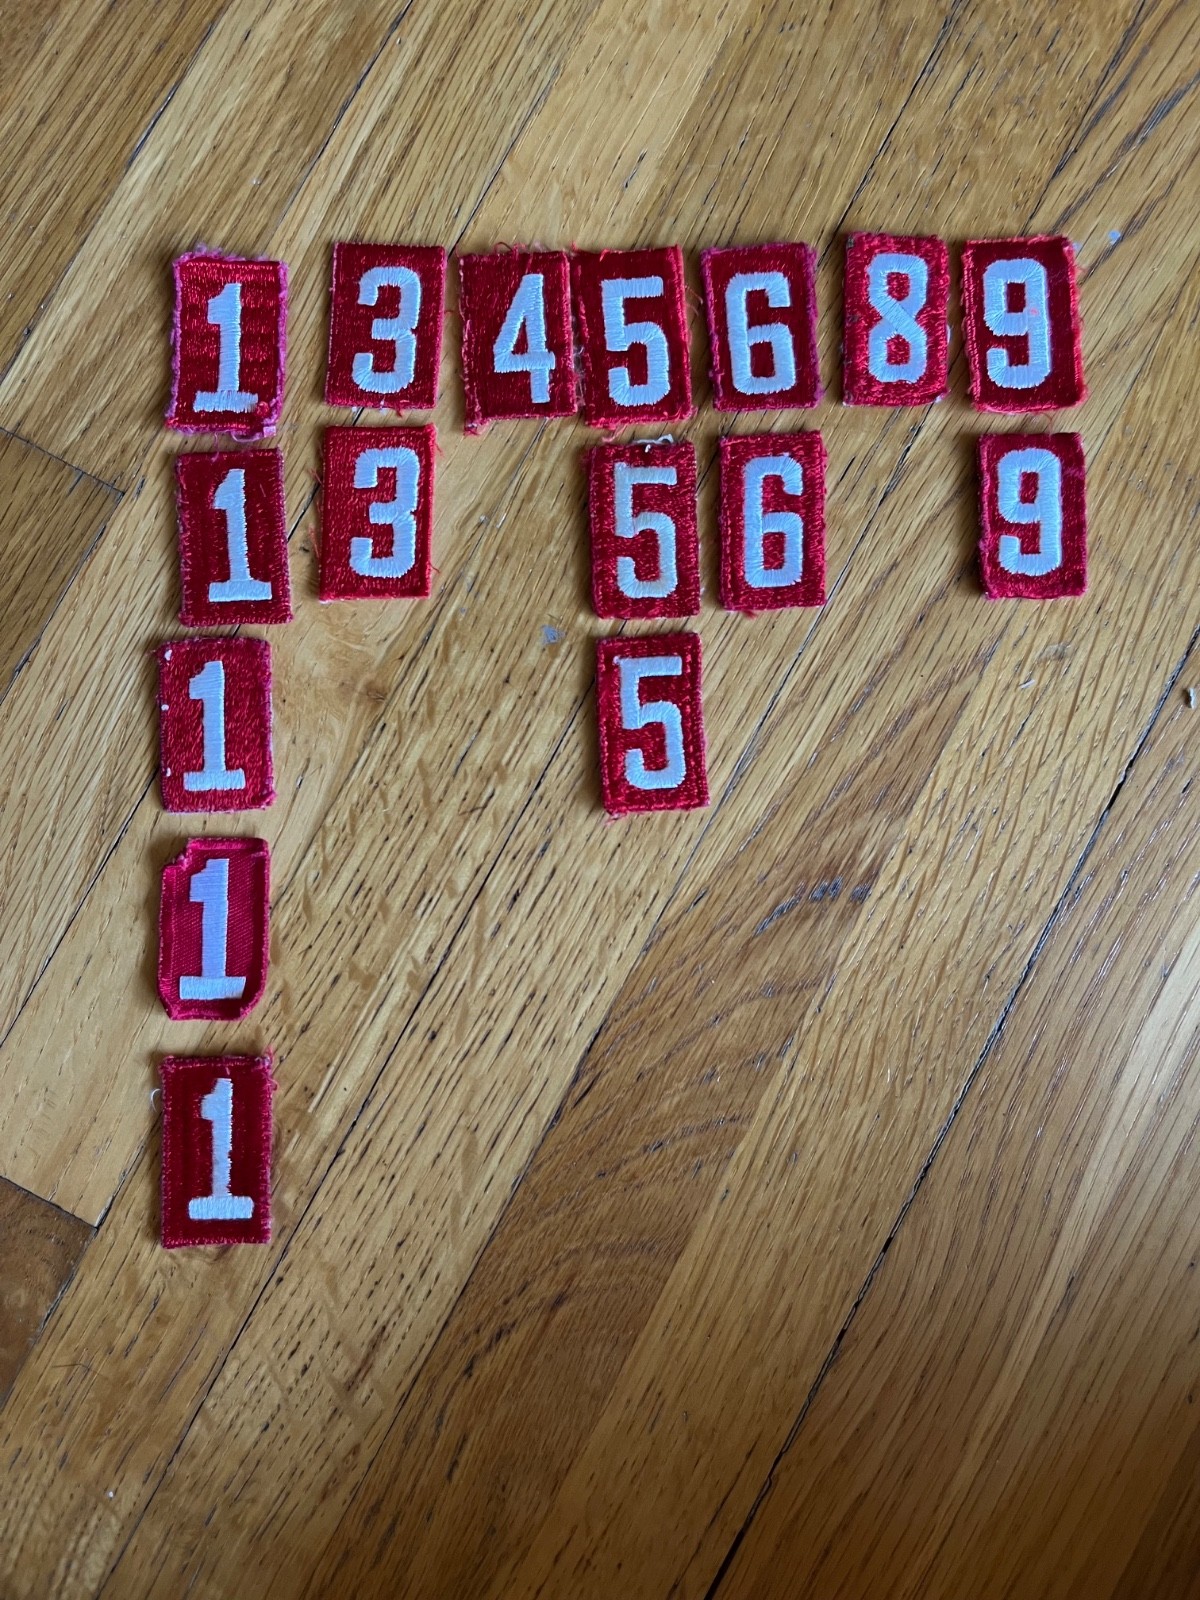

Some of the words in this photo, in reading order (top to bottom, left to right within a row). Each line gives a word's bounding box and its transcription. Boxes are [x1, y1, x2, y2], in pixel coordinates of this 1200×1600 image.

[193, 283, 258, 413] 1
[352, 267, 422, 394] 3
[493, 274, 555, 403] 4
[602, 276, 670, 406] 5
[725, 272, 796, 395] 6
[867, 253, 929, 383] 8
[983, 258, 1052, 389] 9
[208, 469, 272, 602] 1
[349, 447, 420, 578] 3
[615, 463, 677, 598] 5
[744, 453, 804, 588] 6
[998, 448, 1063, 576] 9
[184, 661, 245, 791] 1
[614, 656, 686, 790] 5
[179, 859, 246, 1000] 1
[188, 1078, 254, 1220] 1
